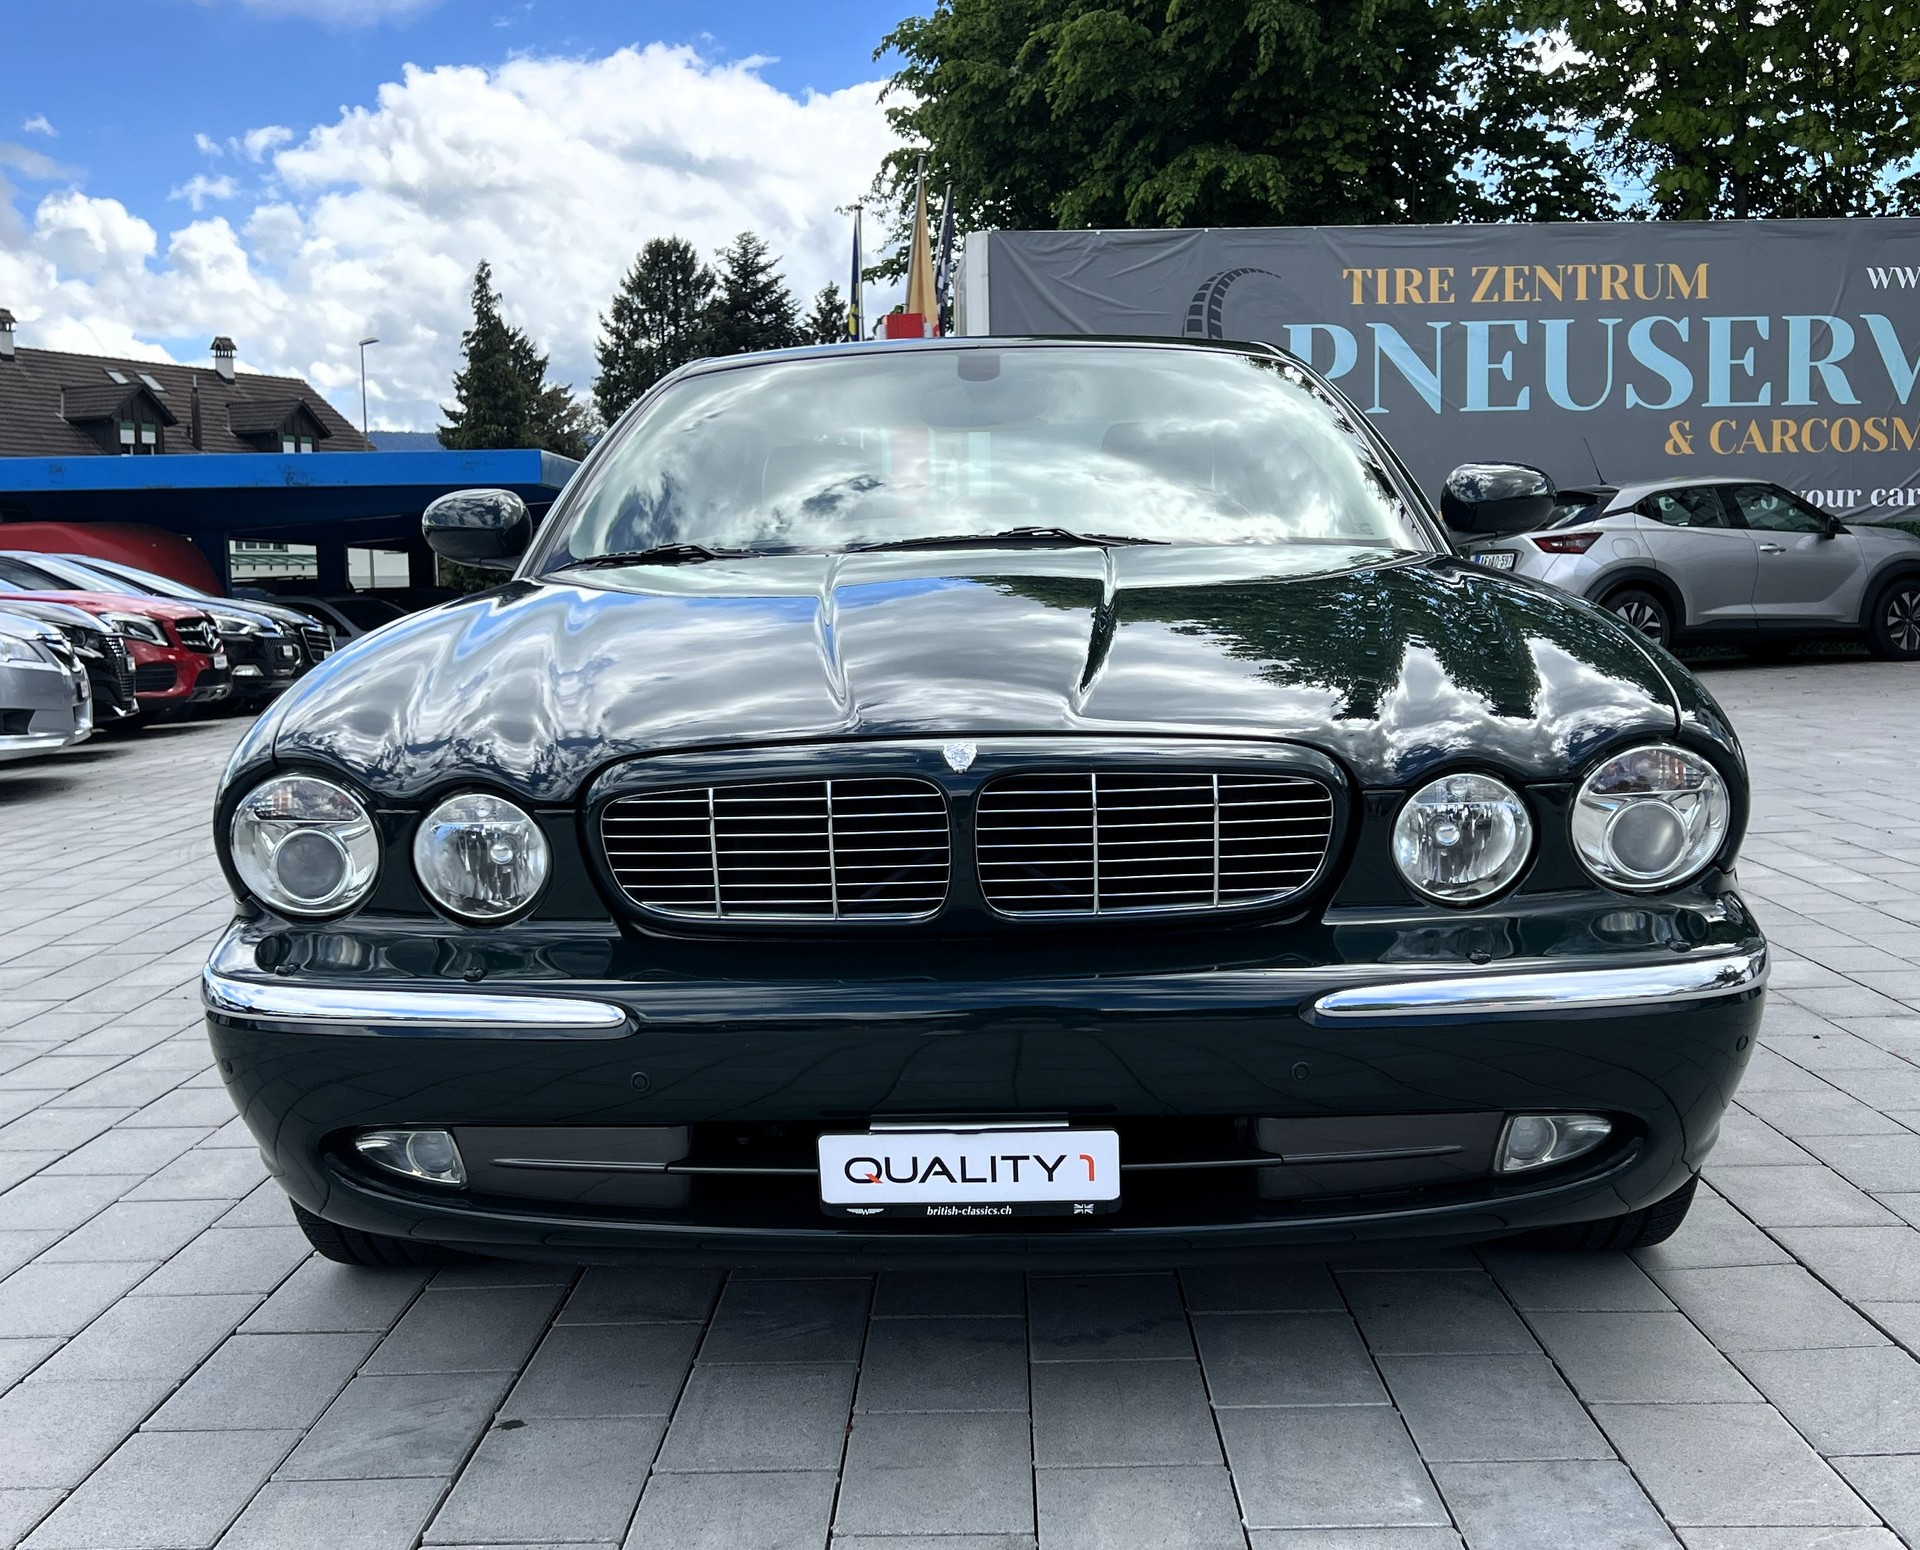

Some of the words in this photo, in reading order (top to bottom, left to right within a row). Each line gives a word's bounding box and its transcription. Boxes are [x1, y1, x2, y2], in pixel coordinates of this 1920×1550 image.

[1342, 266, 1456, 305] TIRE
[1470, 262, 1710, 303] ZENTRUM
[1282, 314, 1920, 414] PNEUSERV
[1664, 420, 1695, 456] &
[1709, 415, 1920, 454] CARCOSM
[844, 1154, 1068, 1184] QUALITY
[926, 1205, 1013, 1217] british-classics.ch
